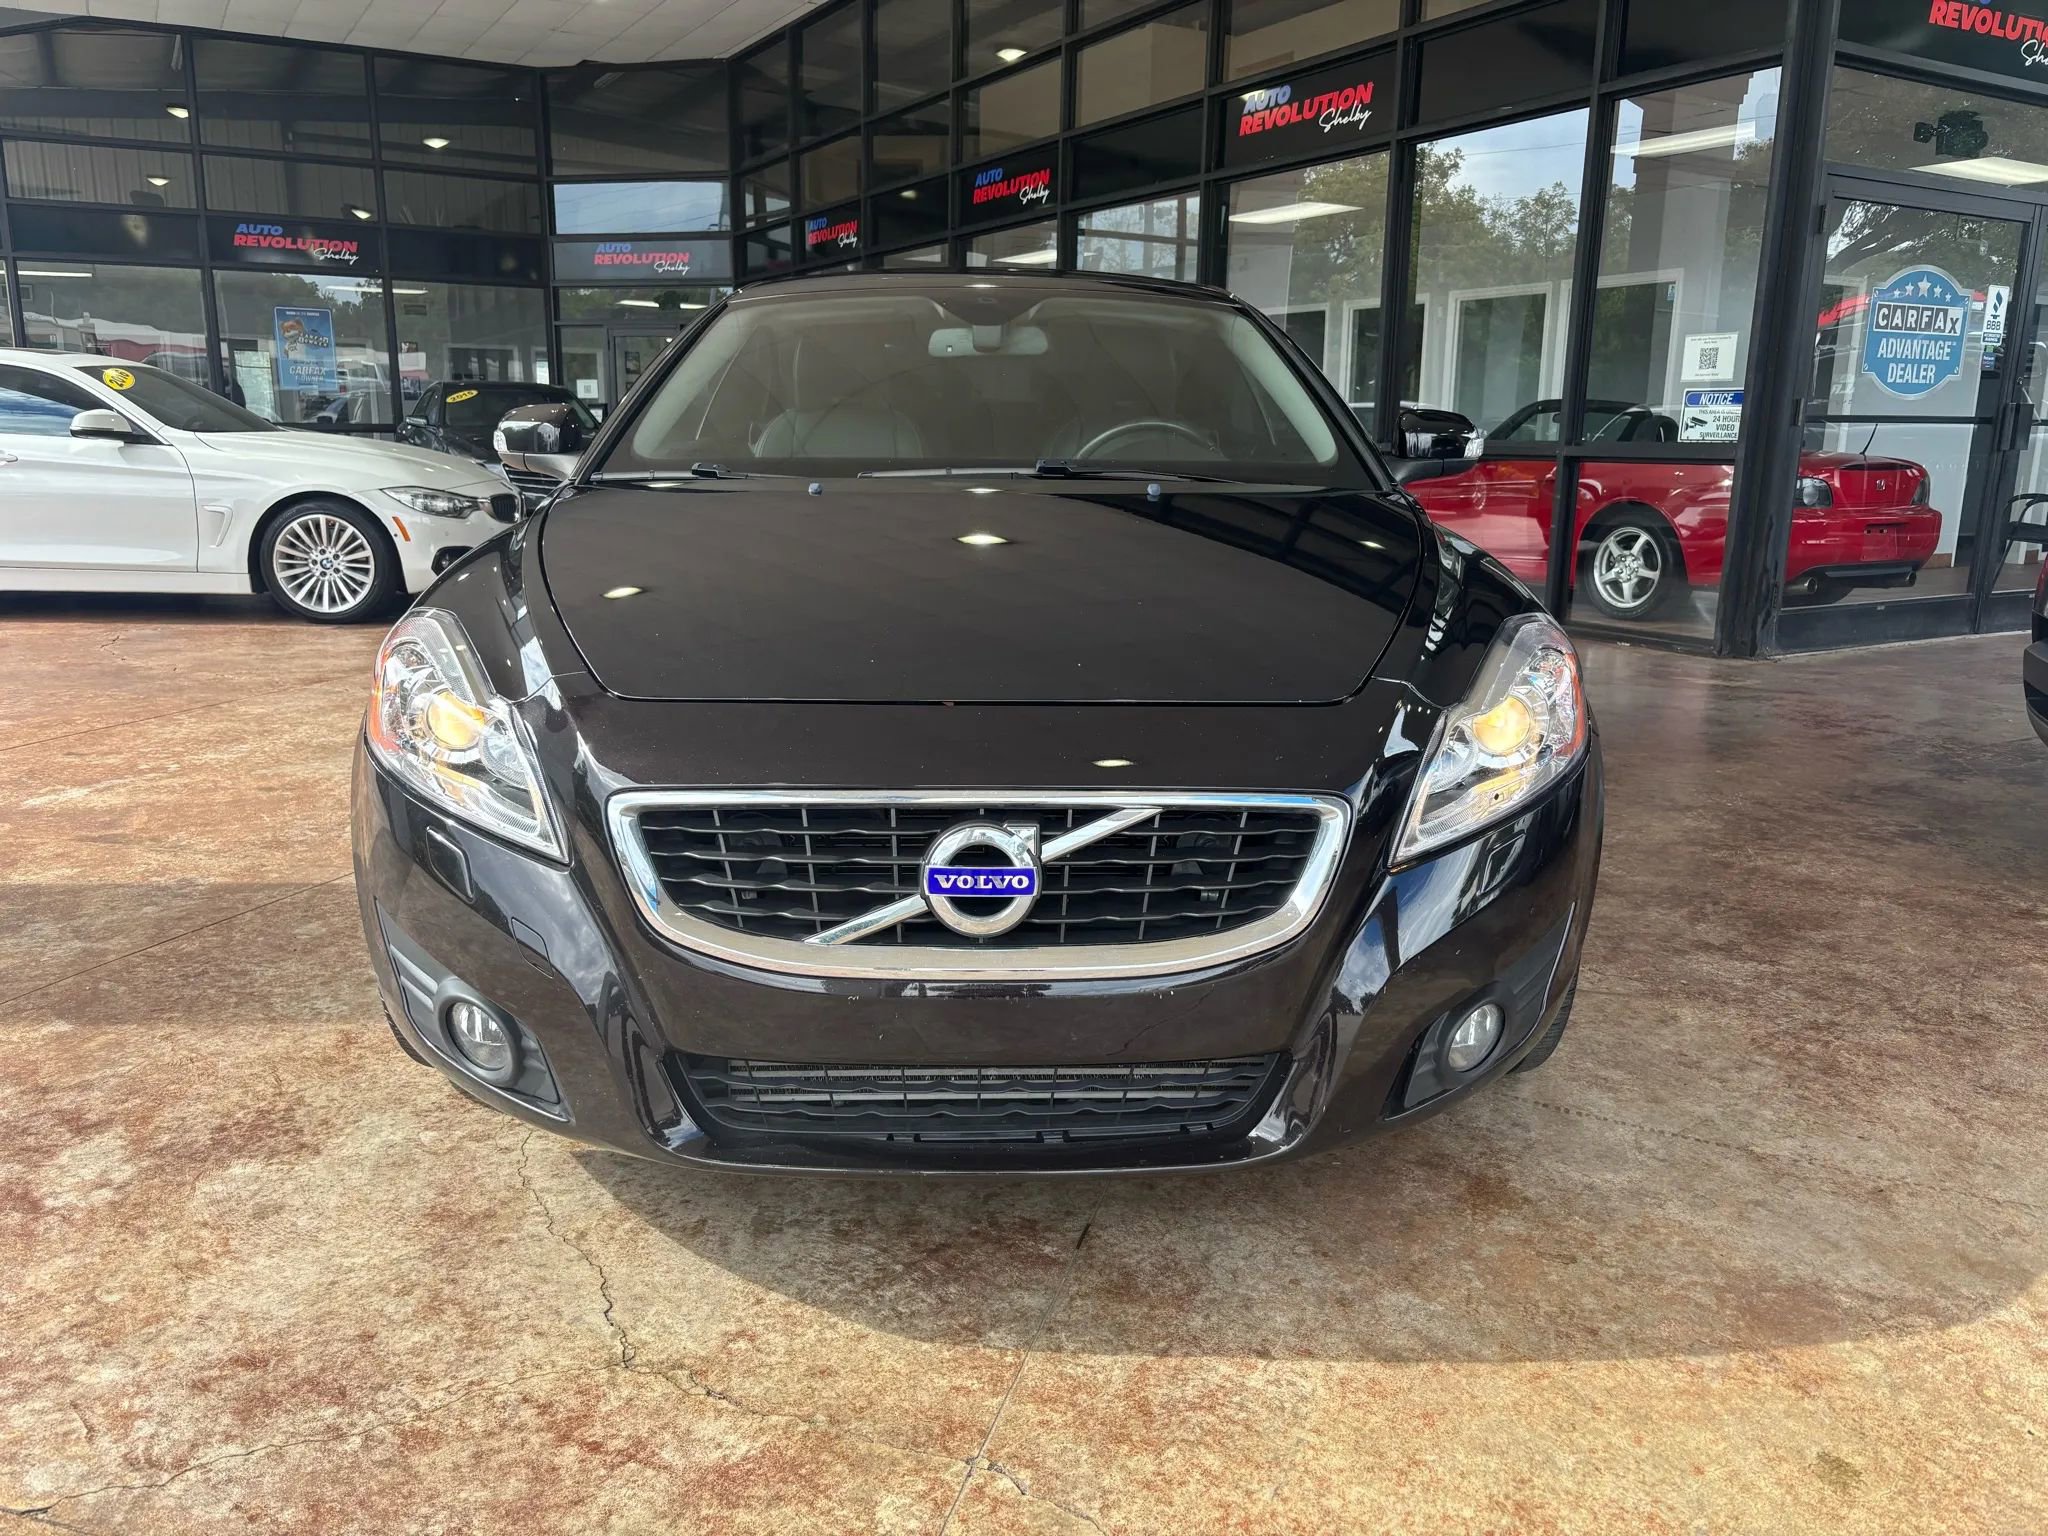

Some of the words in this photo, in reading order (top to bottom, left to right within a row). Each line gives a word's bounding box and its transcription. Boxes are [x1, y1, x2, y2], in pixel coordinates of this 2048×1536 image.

[1239, 82, 1373, 136] REVOLUTION
[1242, 85, 1291, 114] AUTO
[1318, 100, 1372, 133] Shelby
[973, 168, 1050, 204] REVOLUTION
[975, 168, 1003, 187] AUTO
[1019, 181, 1050, 205] Shelby
[236, 223, 283, 235] AUTO
[808, 219, 858, 245] REVOLUTION
[809, 217, 827, 231] AUTO
[233, 234, 358, 252] REVOLUTION
[596, 243, 632, 253] AUTO
[313, 247, 359, 265] Shelby
[594, 252, 690, 265] REVOLUTION
[653, 260, 690, 275] Shelby
[1877, 307, 1960, 335] CARFAX
[1877, 338, 1952, 360] ADVANTAGE
[1887, 363, 1936, 384] DEALER
[1699, 393, 1735, 405] NOTICE
[934, 874, 1030, 889] VOLVO
